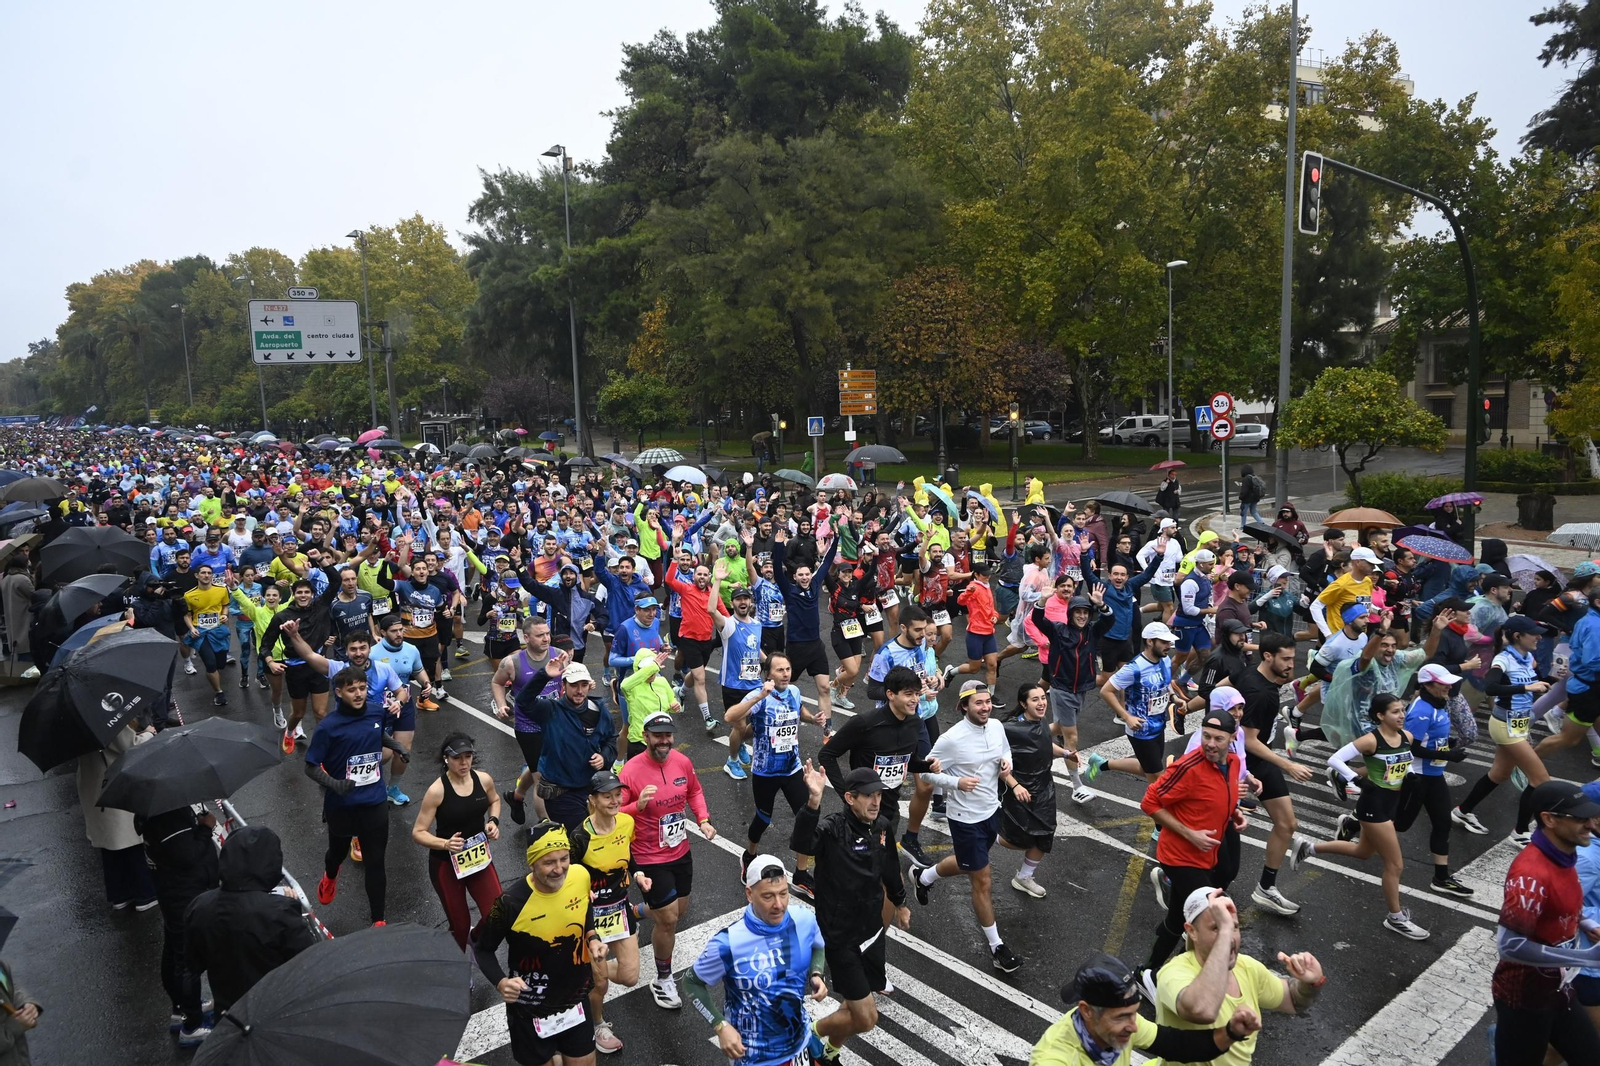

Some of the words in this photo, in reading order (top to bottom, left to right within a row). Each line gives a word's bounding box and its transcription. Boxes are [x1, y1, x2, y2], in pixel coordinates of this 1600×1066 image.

[200, 617, 217, 625] 3408
[343, 613, 368, 623] Emirates
[415, 614, 431, 622] 1213
[745, 665, 758, 673] 796
[776, 725, 797, 737] 4592
[351, 762, 377, 775] 4784
[878, 765, 904, 777] 7554
[667, 821, 685, 836] 274
[457, 844, 486, 865] 5175
[594, 912, 621, 930] 4427
[733, 946, 785, 975] CÓR
[735, 971, 772, 991] DO
